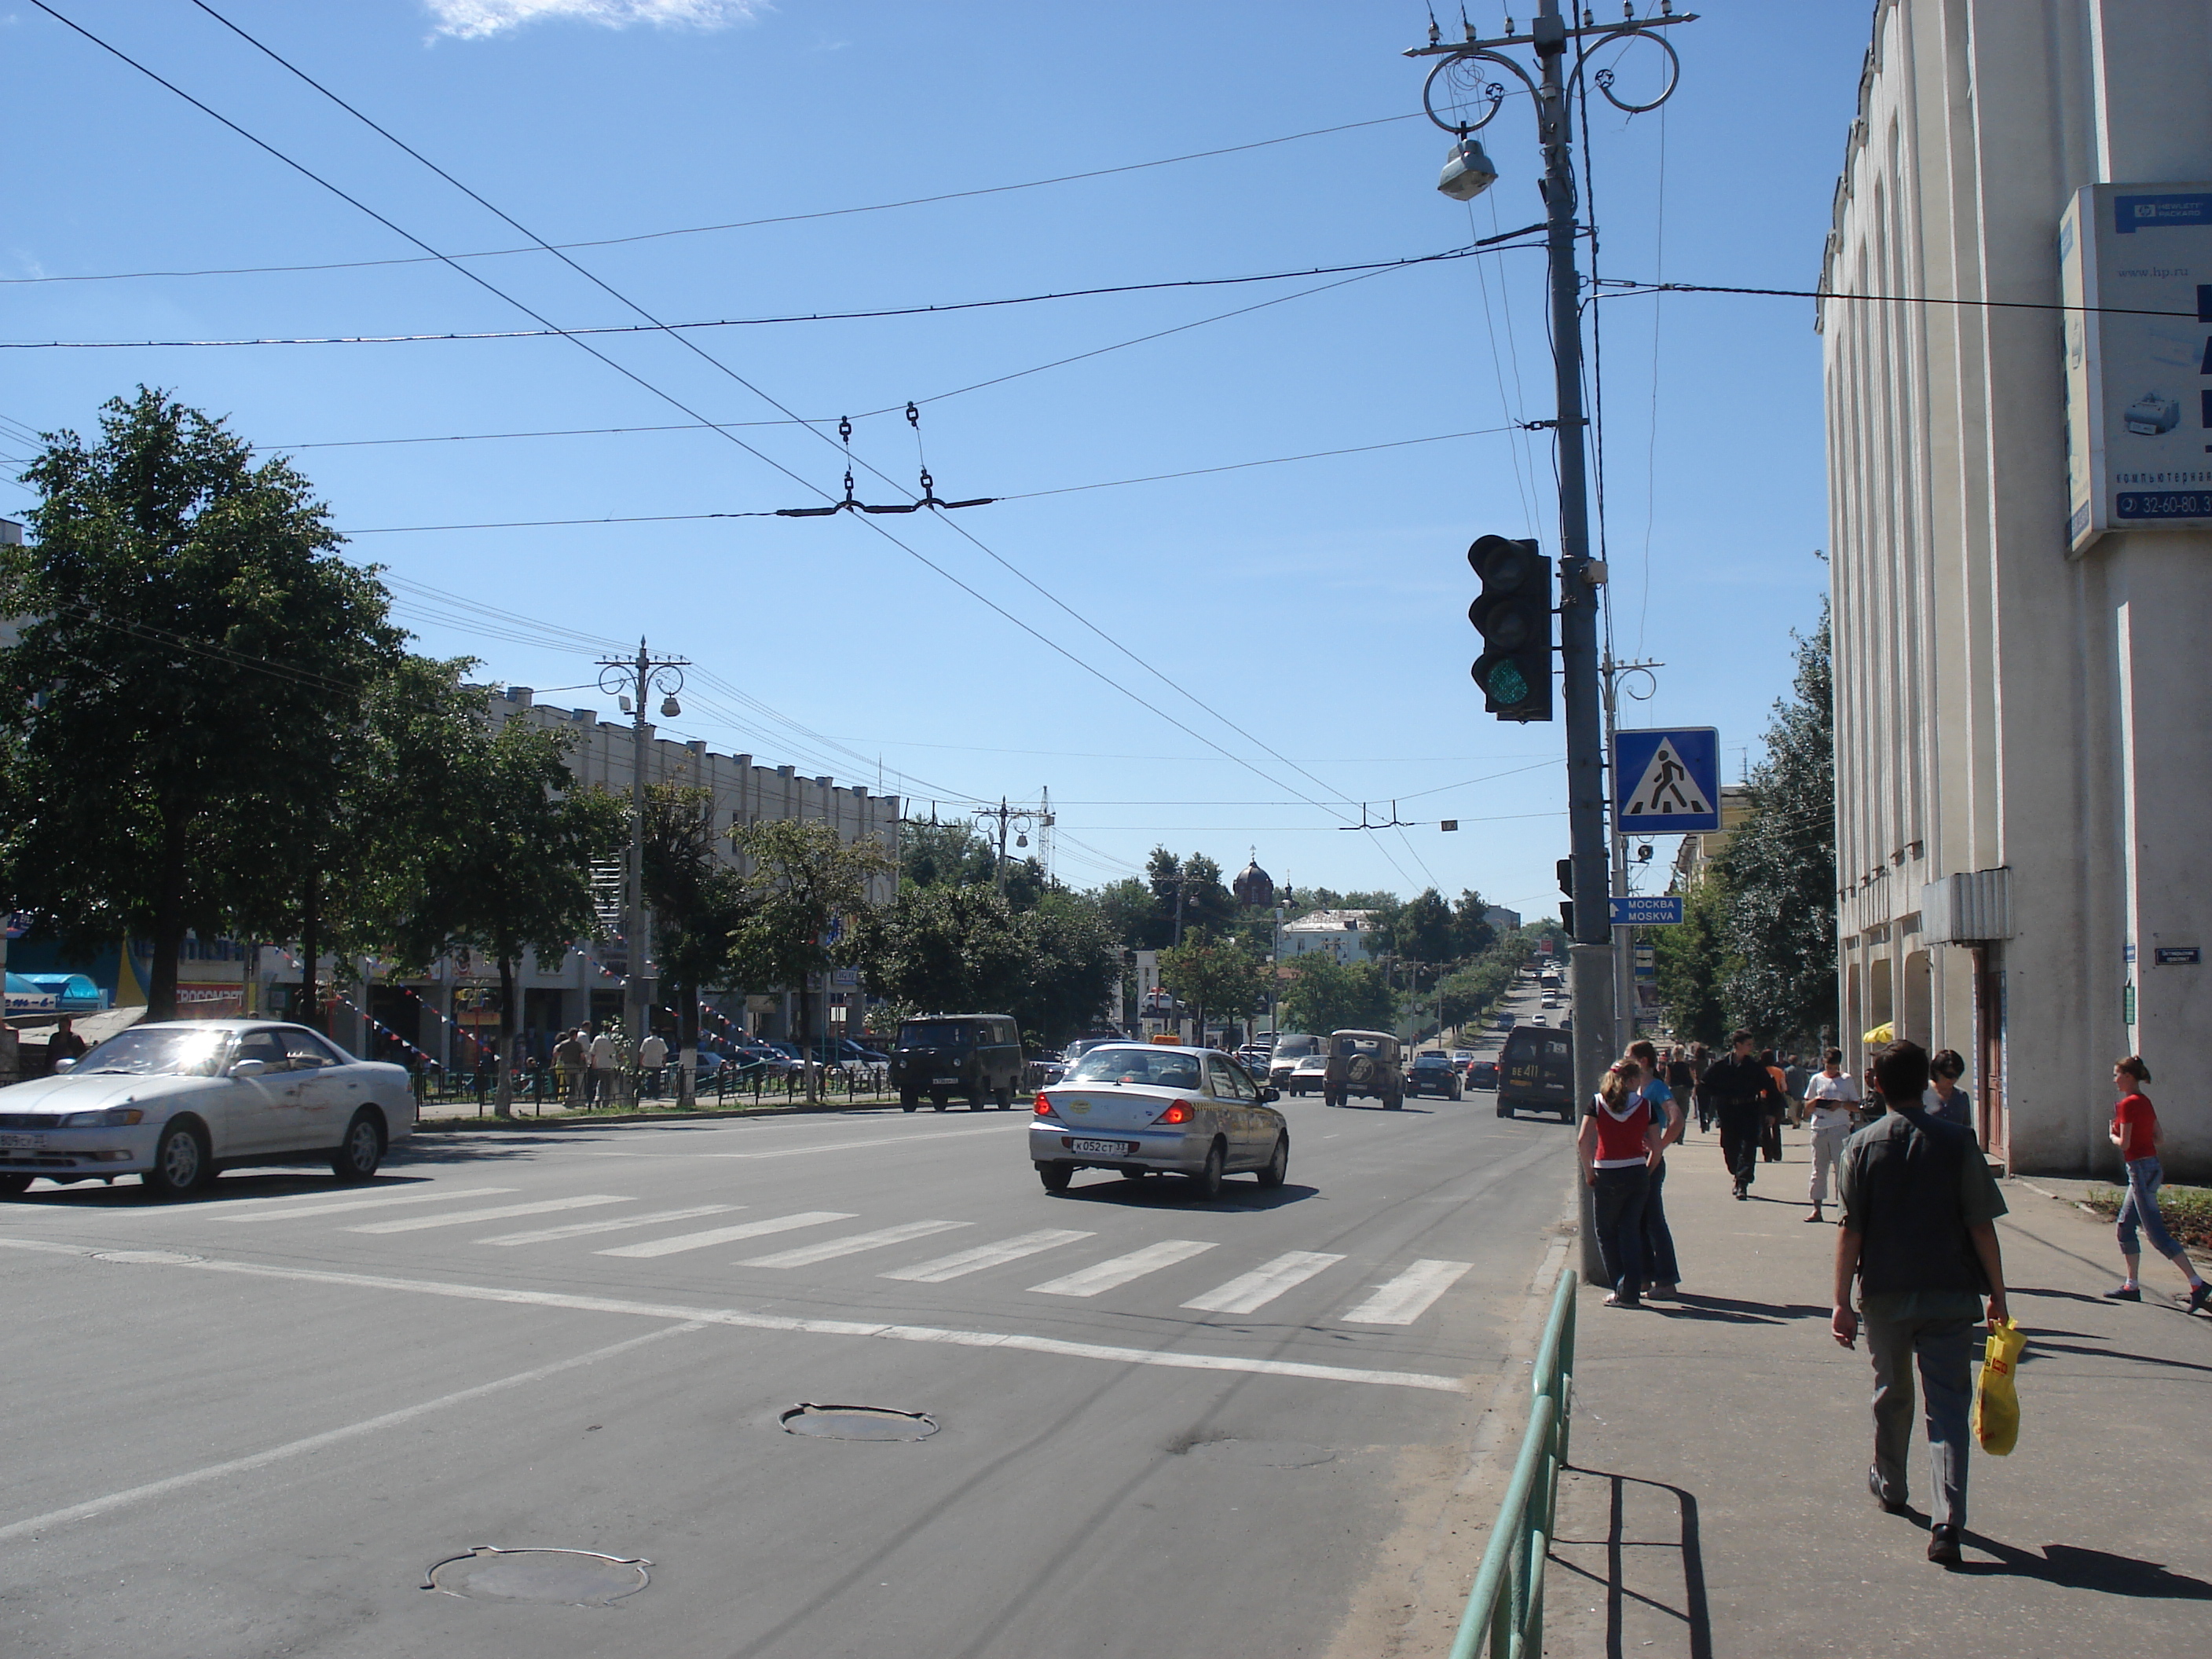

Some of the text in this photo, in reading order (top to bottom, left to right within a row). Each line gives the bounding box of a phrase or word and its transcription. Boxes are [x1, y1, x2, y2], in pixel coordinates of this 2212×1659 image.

[2118, 267, 2189, 280] www.hp.ru
[1628, 900, 1675, 909] МОСКВА
[1628, 912, 1674, 921] MOSKVA
[1523, 1064, 1538, 1077] 411
